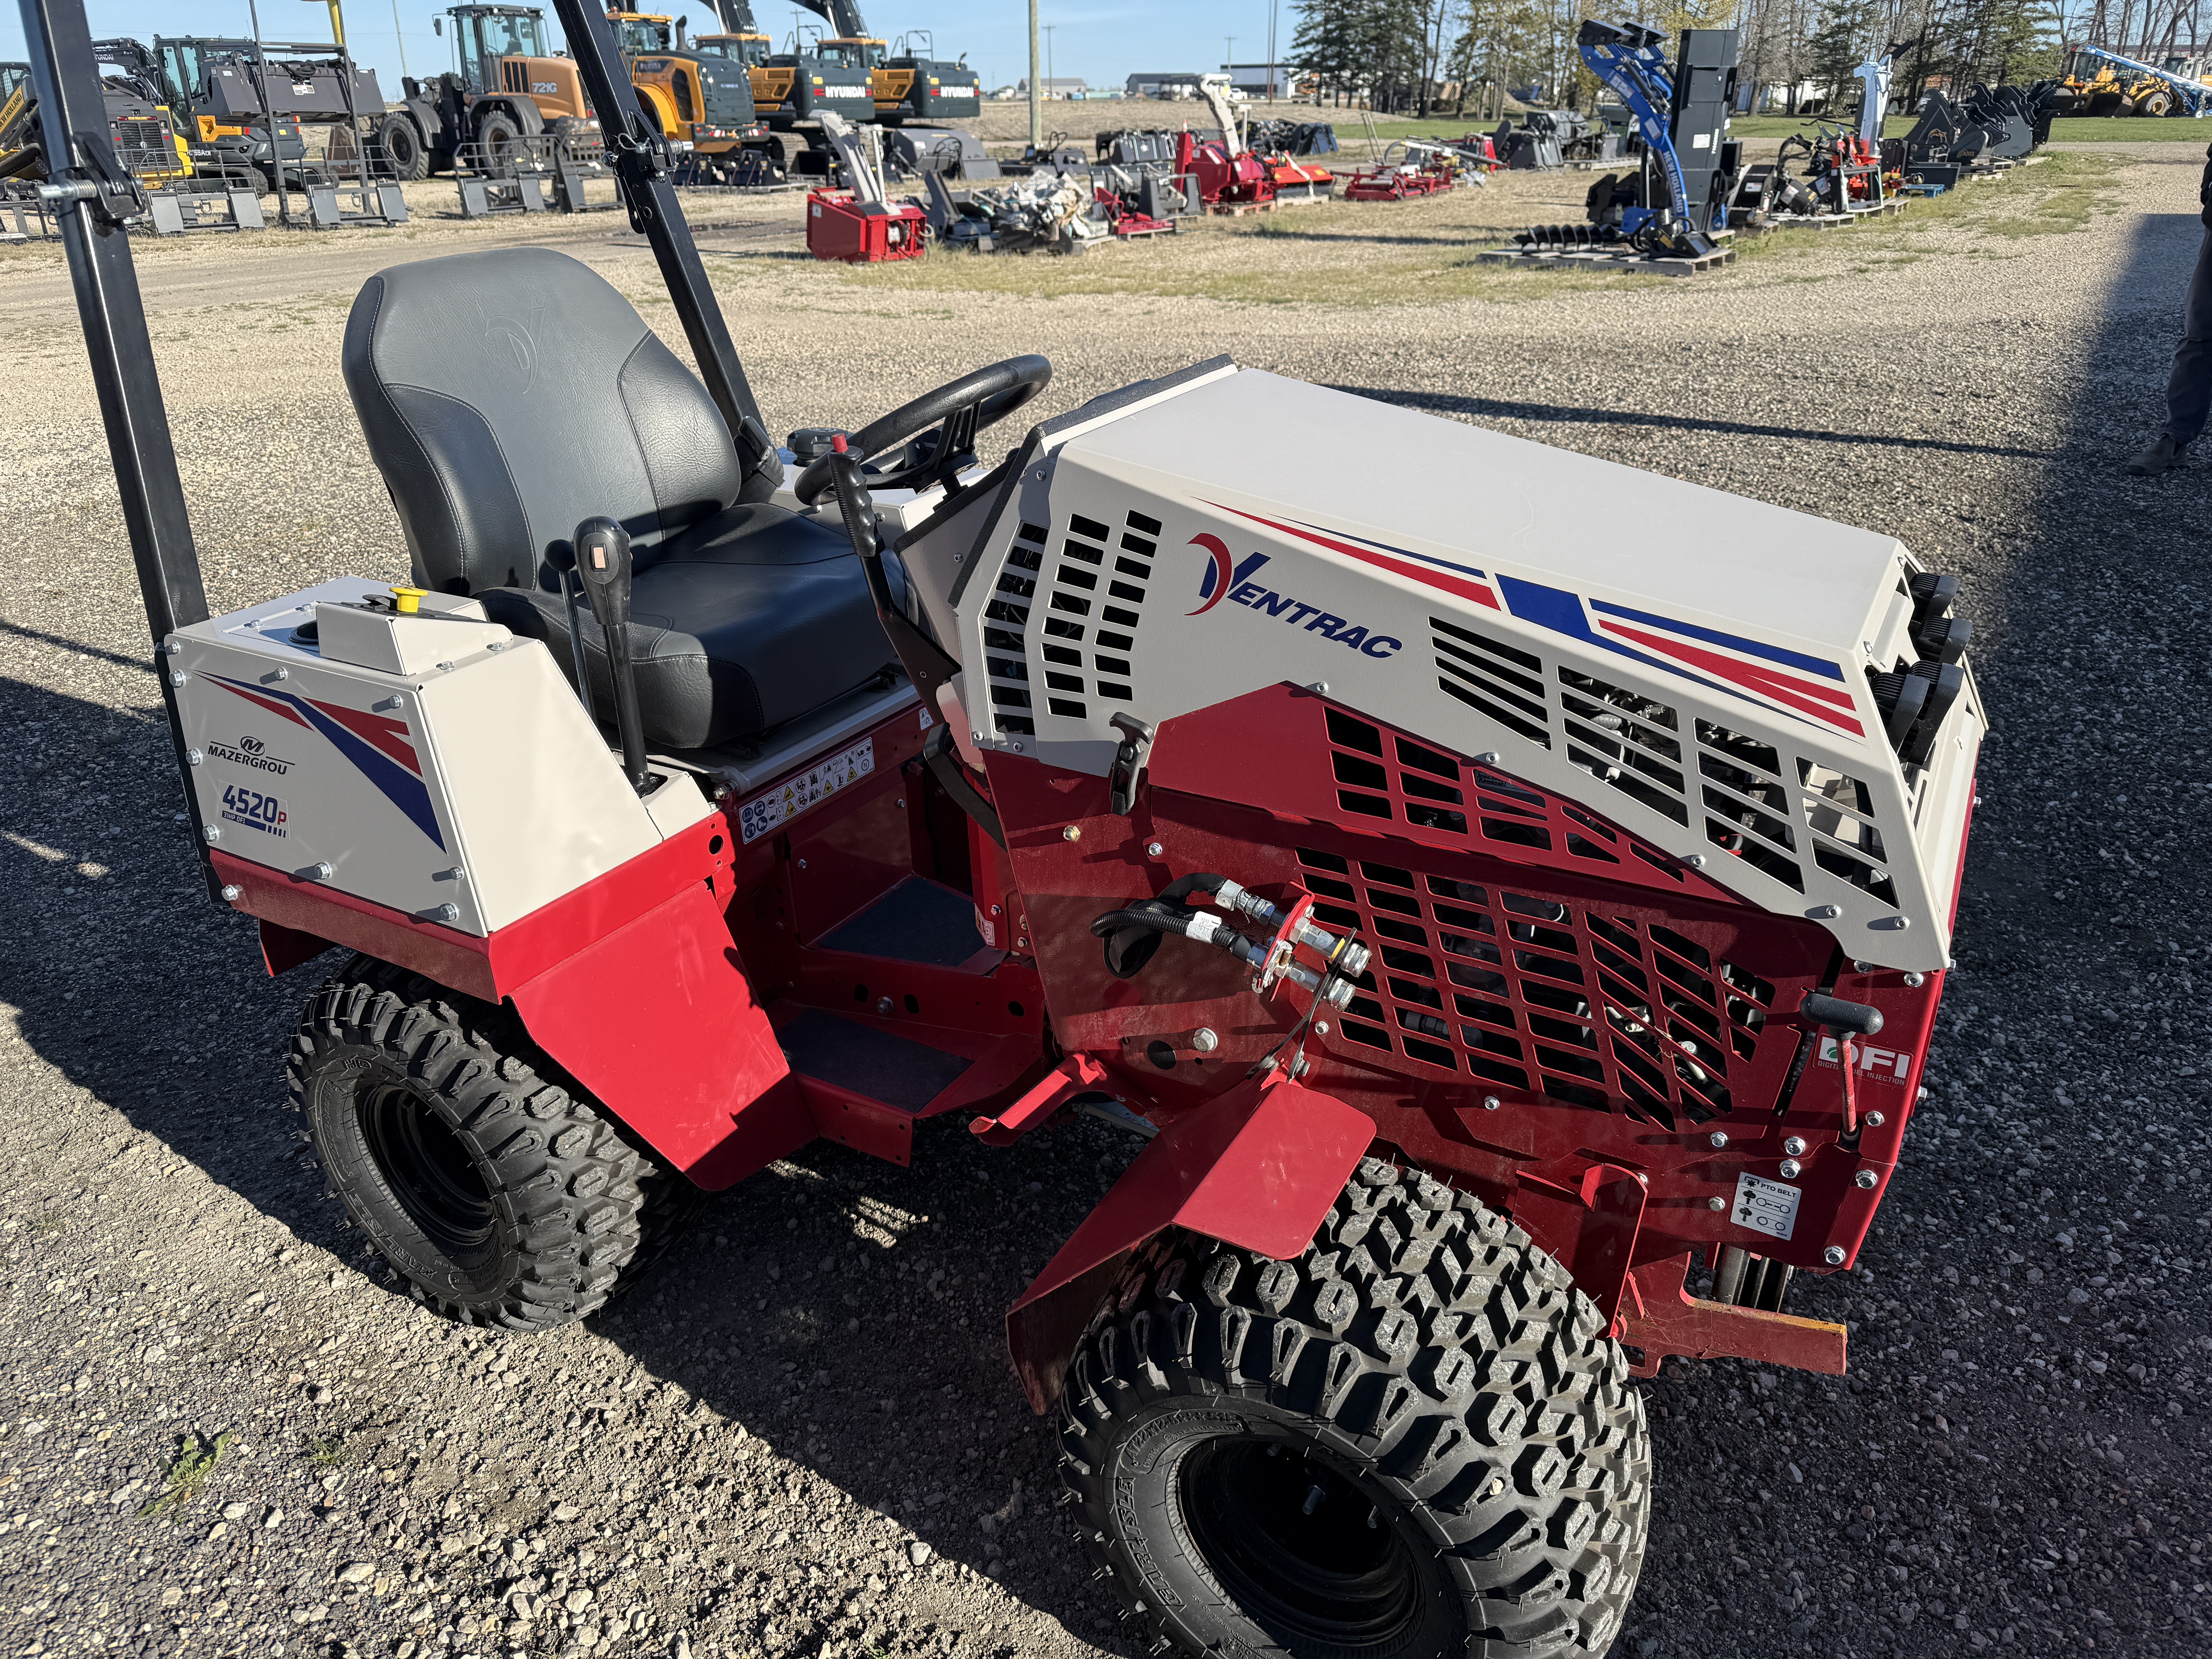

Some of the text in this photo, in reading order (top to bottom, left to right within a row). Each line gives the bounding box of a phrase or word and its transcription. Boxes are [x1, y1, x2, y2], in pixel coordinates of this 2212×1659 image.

[533, 82, 557, 93] 721G
[825, 86, 866, 98] HYUNDAI
[941, 86, 974, 98] HYUNDAI
[5, 93, 22, 118] HOLLAND
[1663, 151, 1683, 213] NEW HOLLAND
[1184, 533, 1402, 658] VENTRAC
[208, 745, 287, 775] MAZERGROU
[1479, 777, 1506, 787] Kawasaki
[223, 811, 246, 824] 31HP DFI
[1867, 1072, 1905, 1085] INJECTION
[1760, 1183, 1797, 1197] PTO BELT
[348, 1193, 435, 1279] CARLISLE
[1115, 1476, 1183, 1606] CARLISLE
